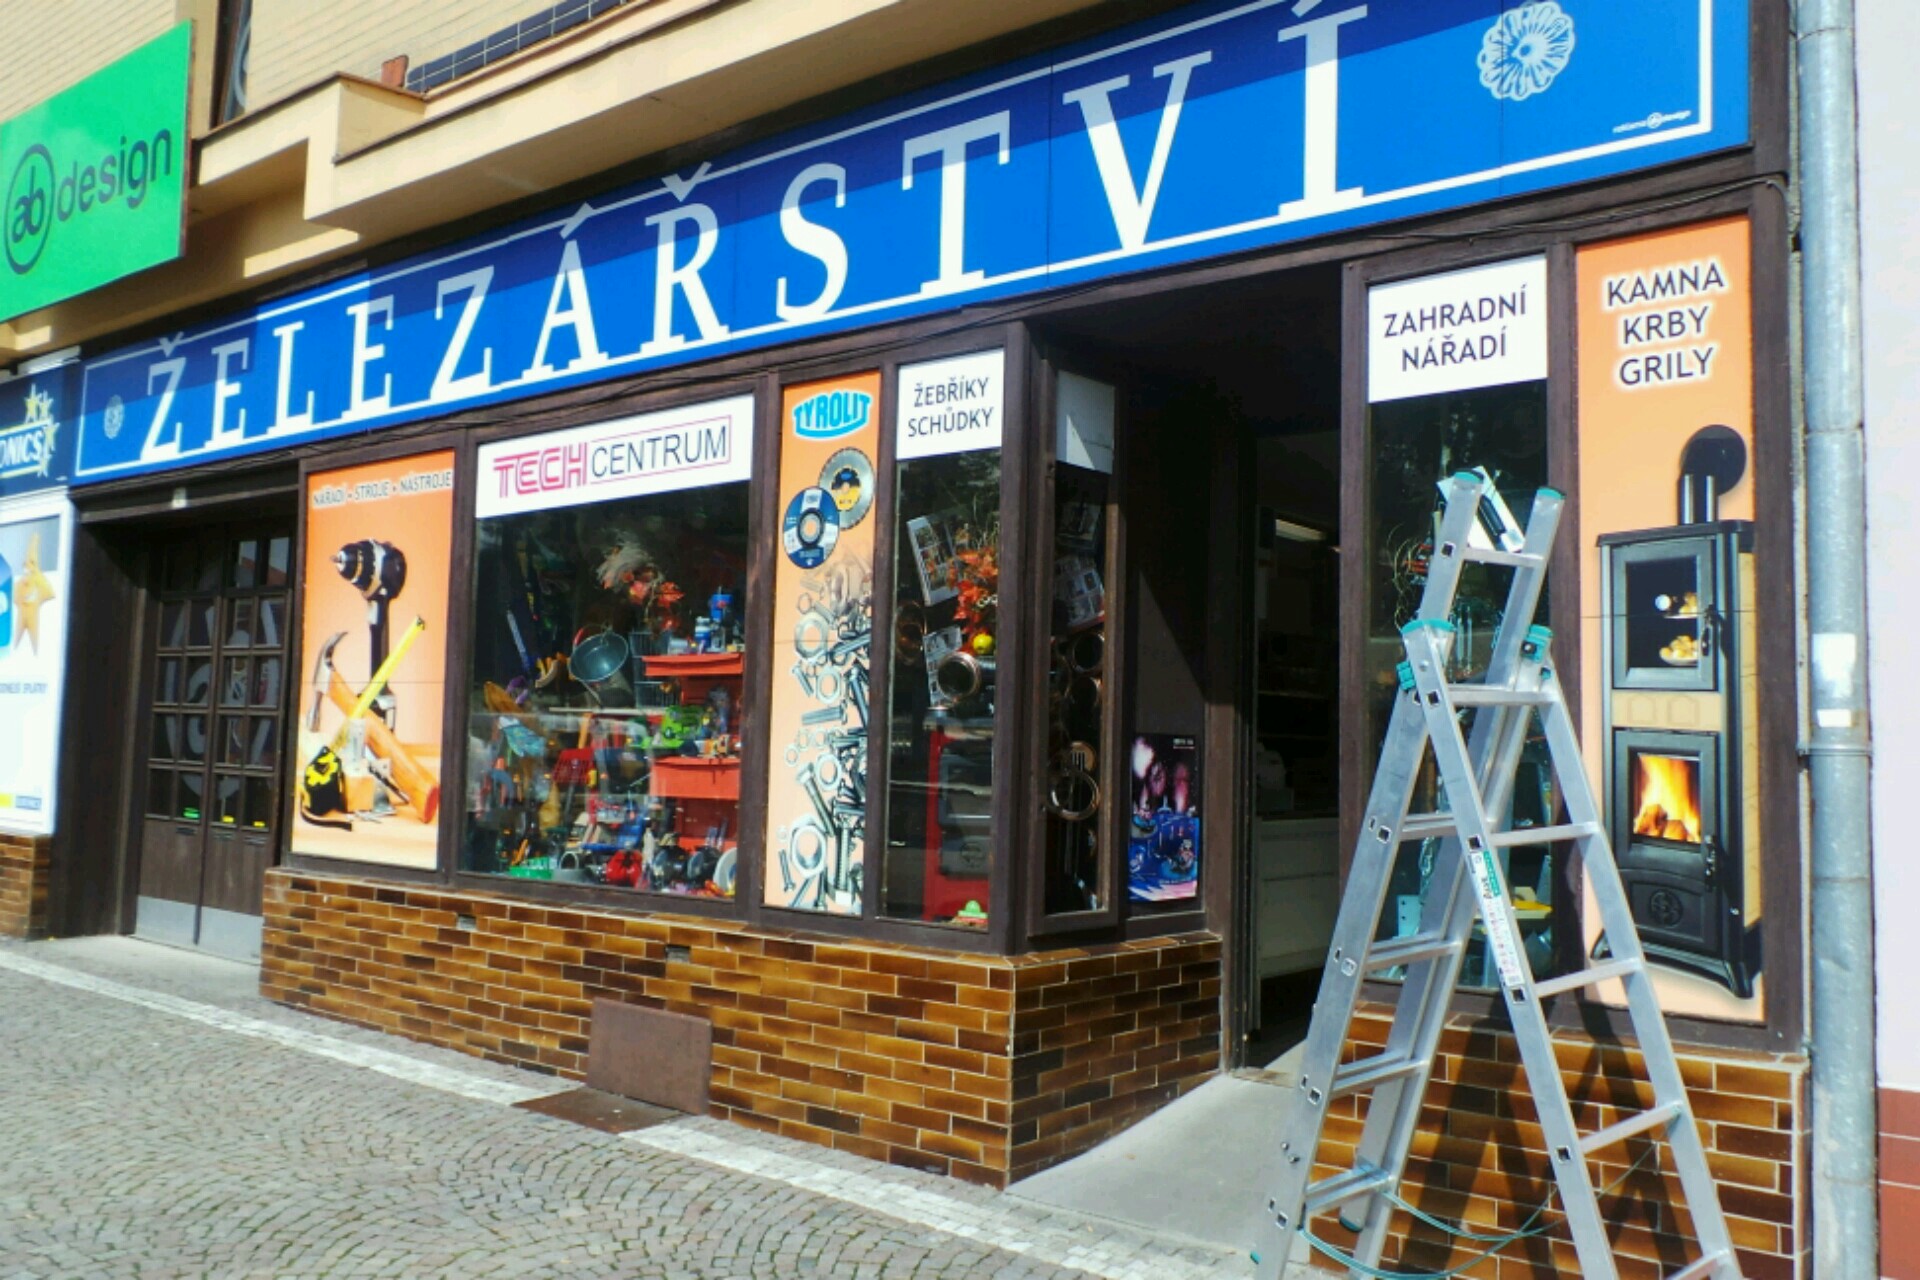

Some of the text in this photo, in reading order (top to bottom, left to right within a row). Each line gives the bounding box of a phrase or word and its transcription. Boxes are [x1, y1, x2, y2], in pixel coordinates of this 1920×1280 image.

[57, 128, 172, 222] design
[140, 0, 1368, 461] ŽELEZÁŘSTVÍ
[1606, 262, 1724, 307] KAMNA
[1383, 283, 1528, 338] ZAHRADNÍ
[1622, 305, 1710, 345] KRBY
[1401, 326, 1507, 372] NÁŘADÍ
[1618, 346, 1714, 386] GRILY
[912, 374, 990, 408] ŽEBŘÍKY
[793, 392, 872, 432] TYROLIT
[907, 406, 994, 438] SCHŮDKY
[354, 481, 390, 500] STROJE
[400, 471, 452, 493] NÁSTROJE
